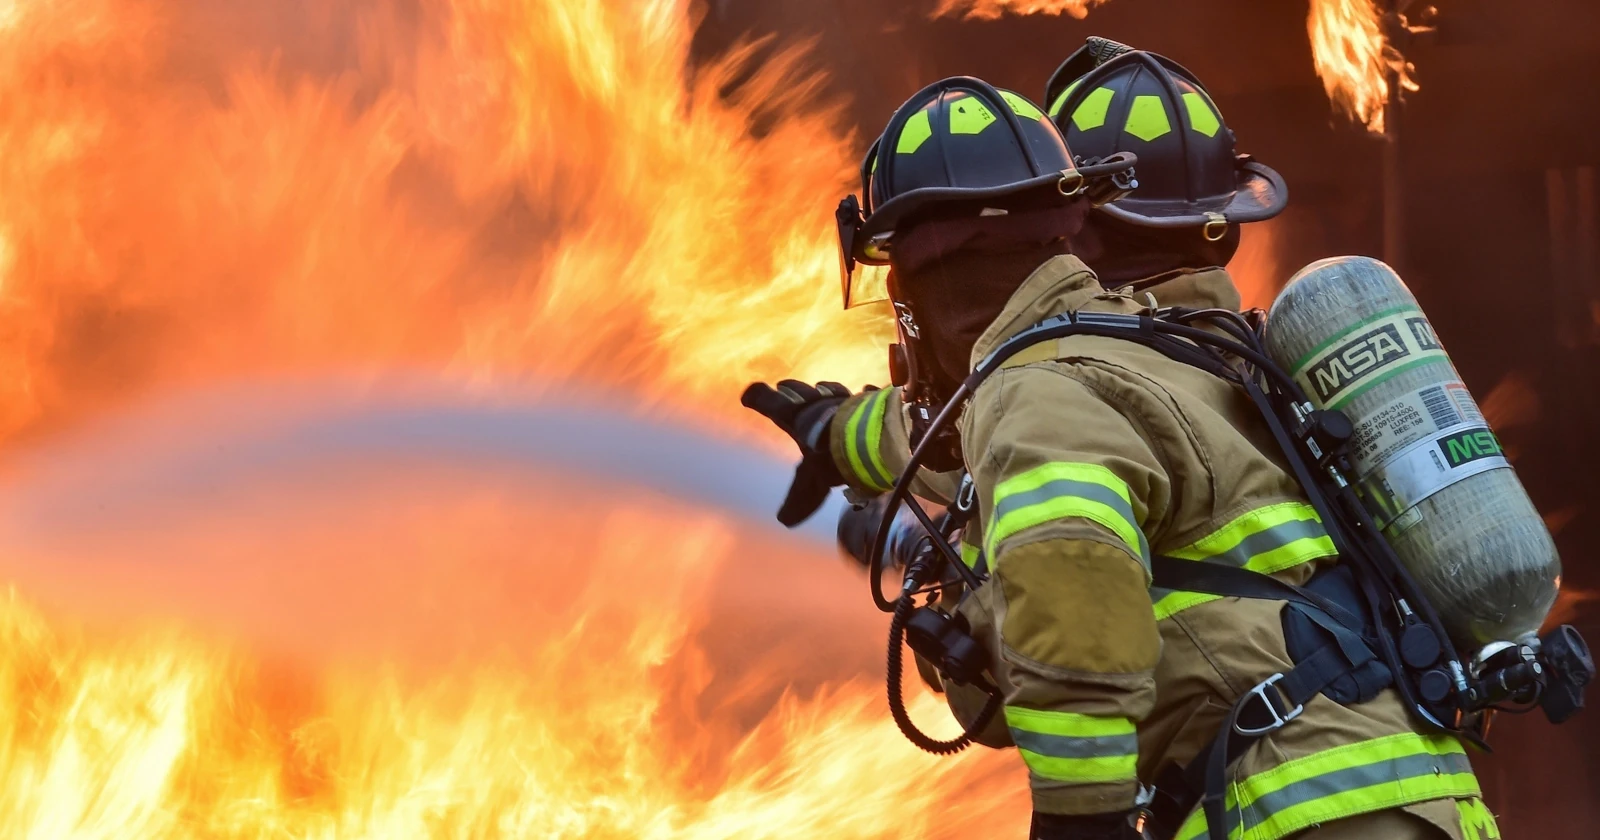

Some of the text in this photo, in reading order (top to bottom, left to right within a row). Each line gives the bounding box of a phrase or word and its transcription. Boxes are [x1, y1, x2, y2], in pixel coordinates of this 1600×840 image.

[1314, 331, 1404, 396] MSA
[1372, 402, 1404, 423] 5134-310
[1374, 405, 1414, 431] 10915-4500
[1389, 411, 1419, 429] LUXFER
